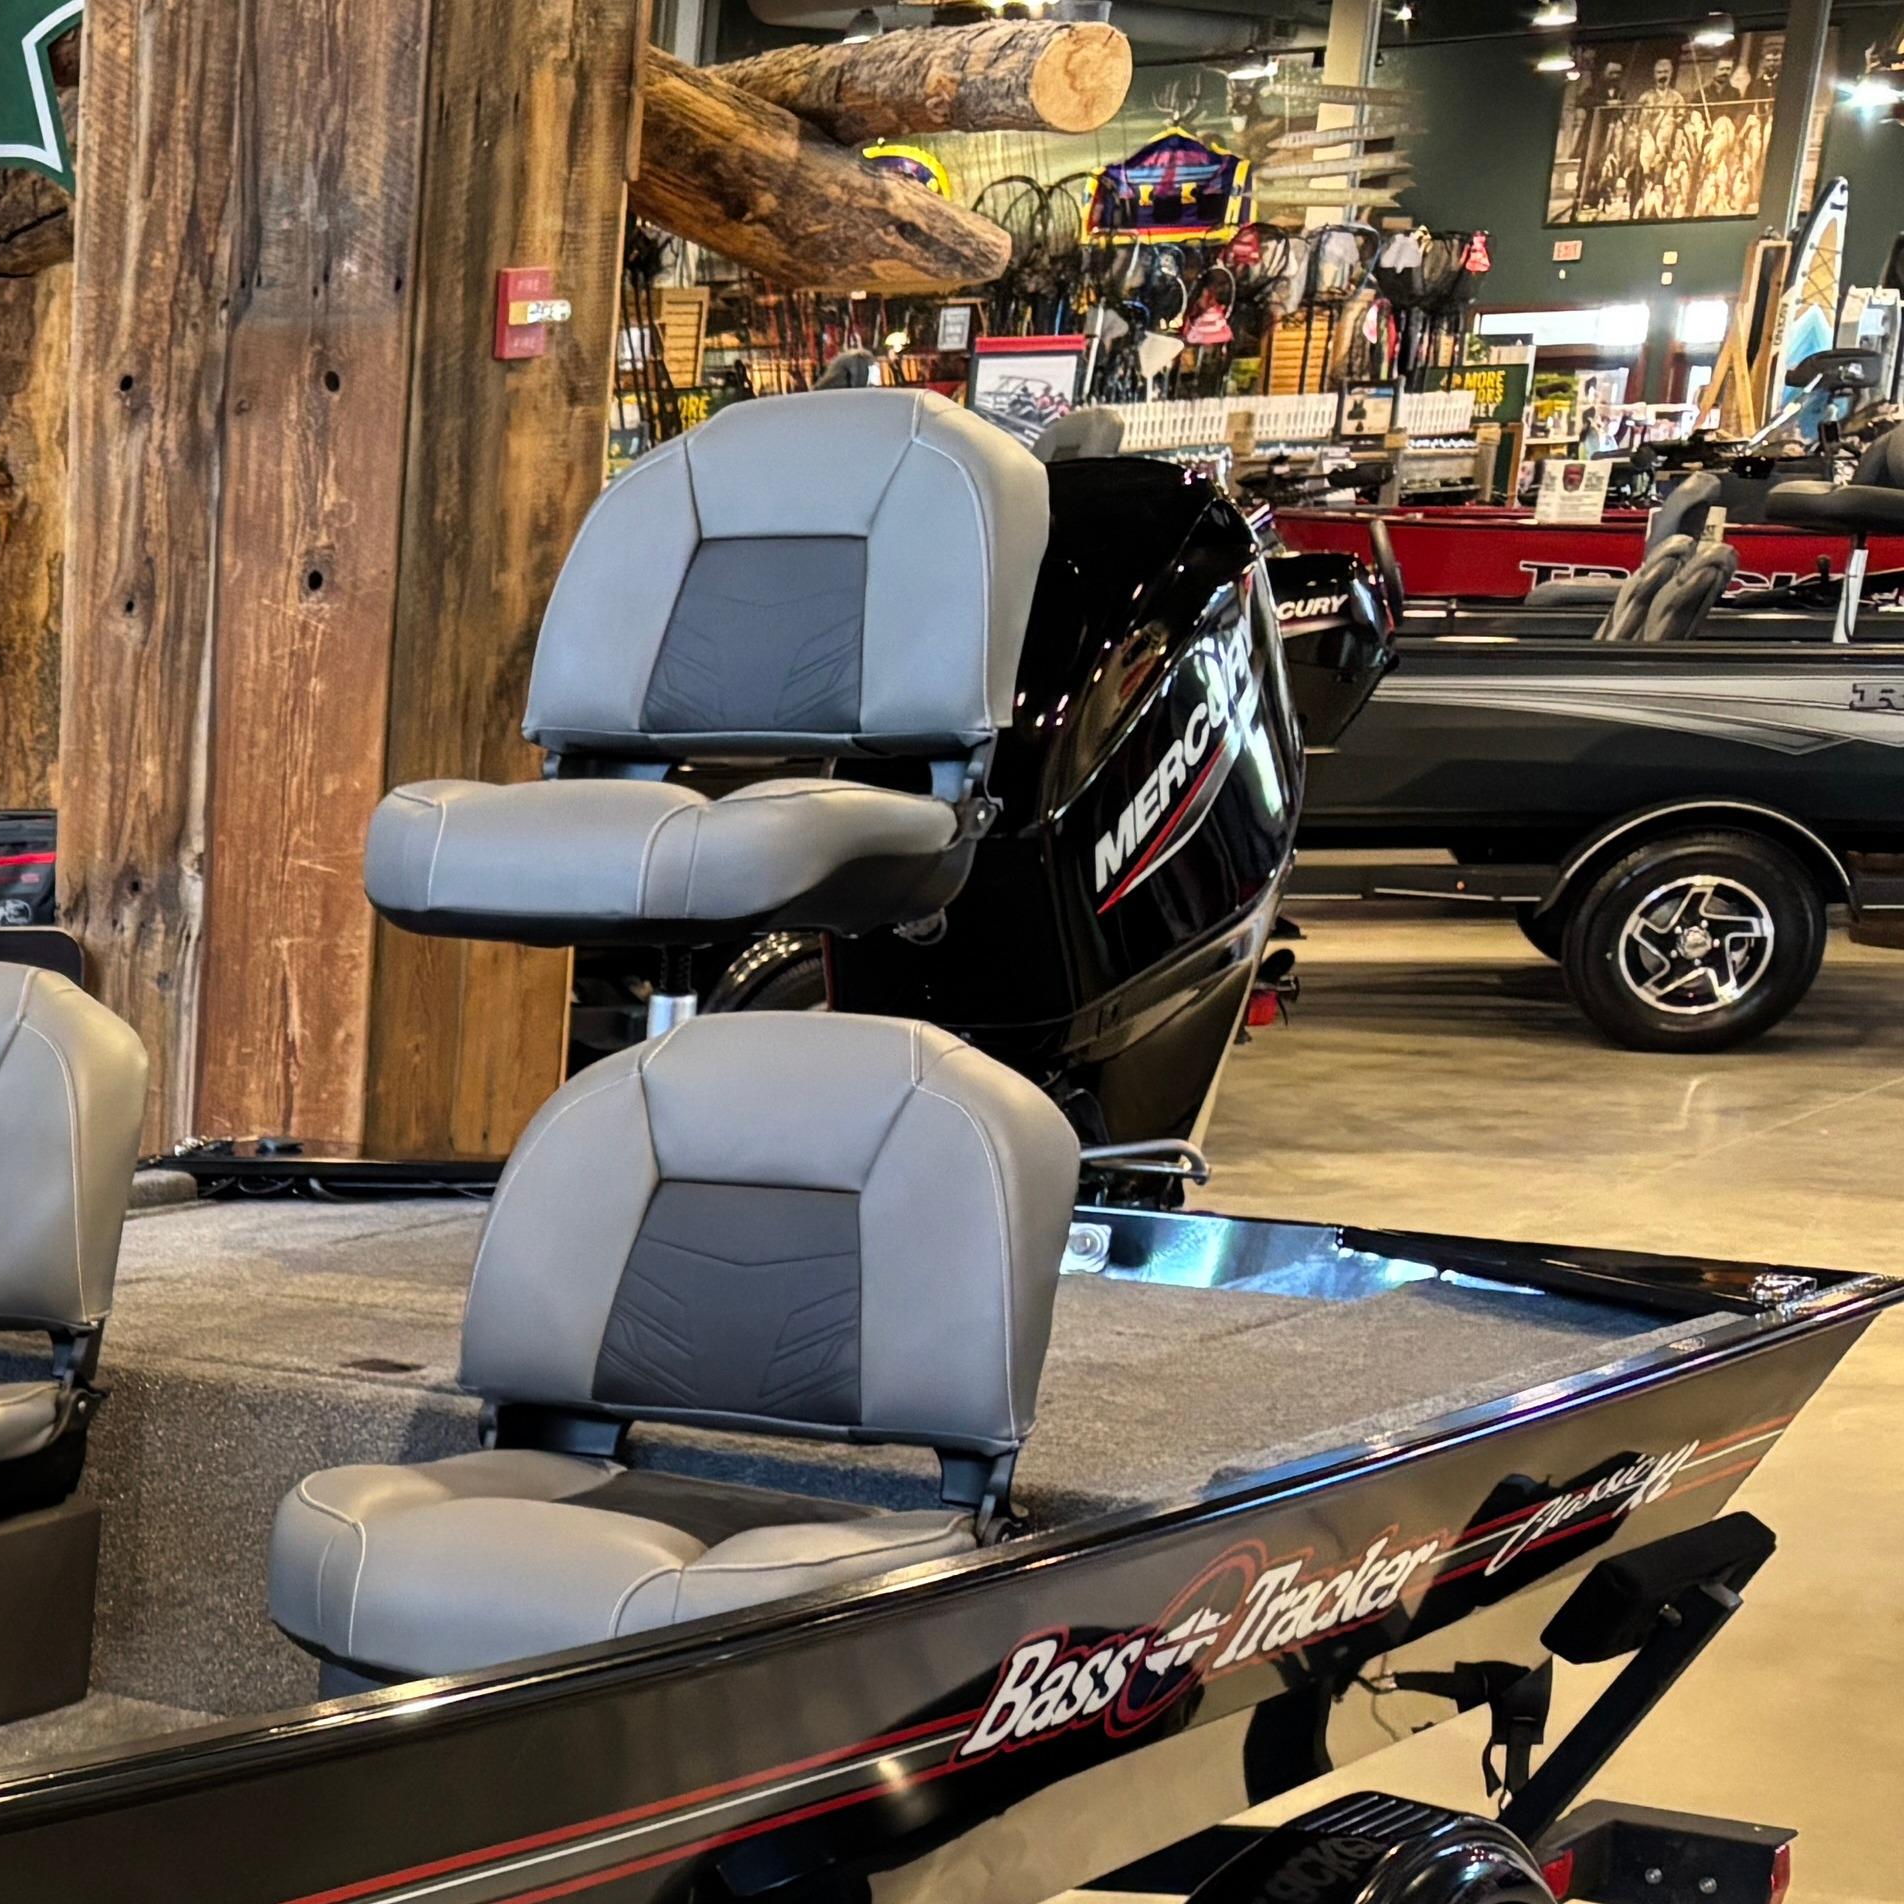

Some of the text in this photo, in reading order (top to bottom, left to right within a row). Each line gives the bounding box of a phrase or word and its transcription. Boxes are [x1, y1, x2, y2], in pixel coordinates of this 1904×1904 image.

[1463, 370, 1506, 389] MORE
[1275, 594, 1349, 620] CURY
[960, 1537, 1440, 1756] Bass Tracker
